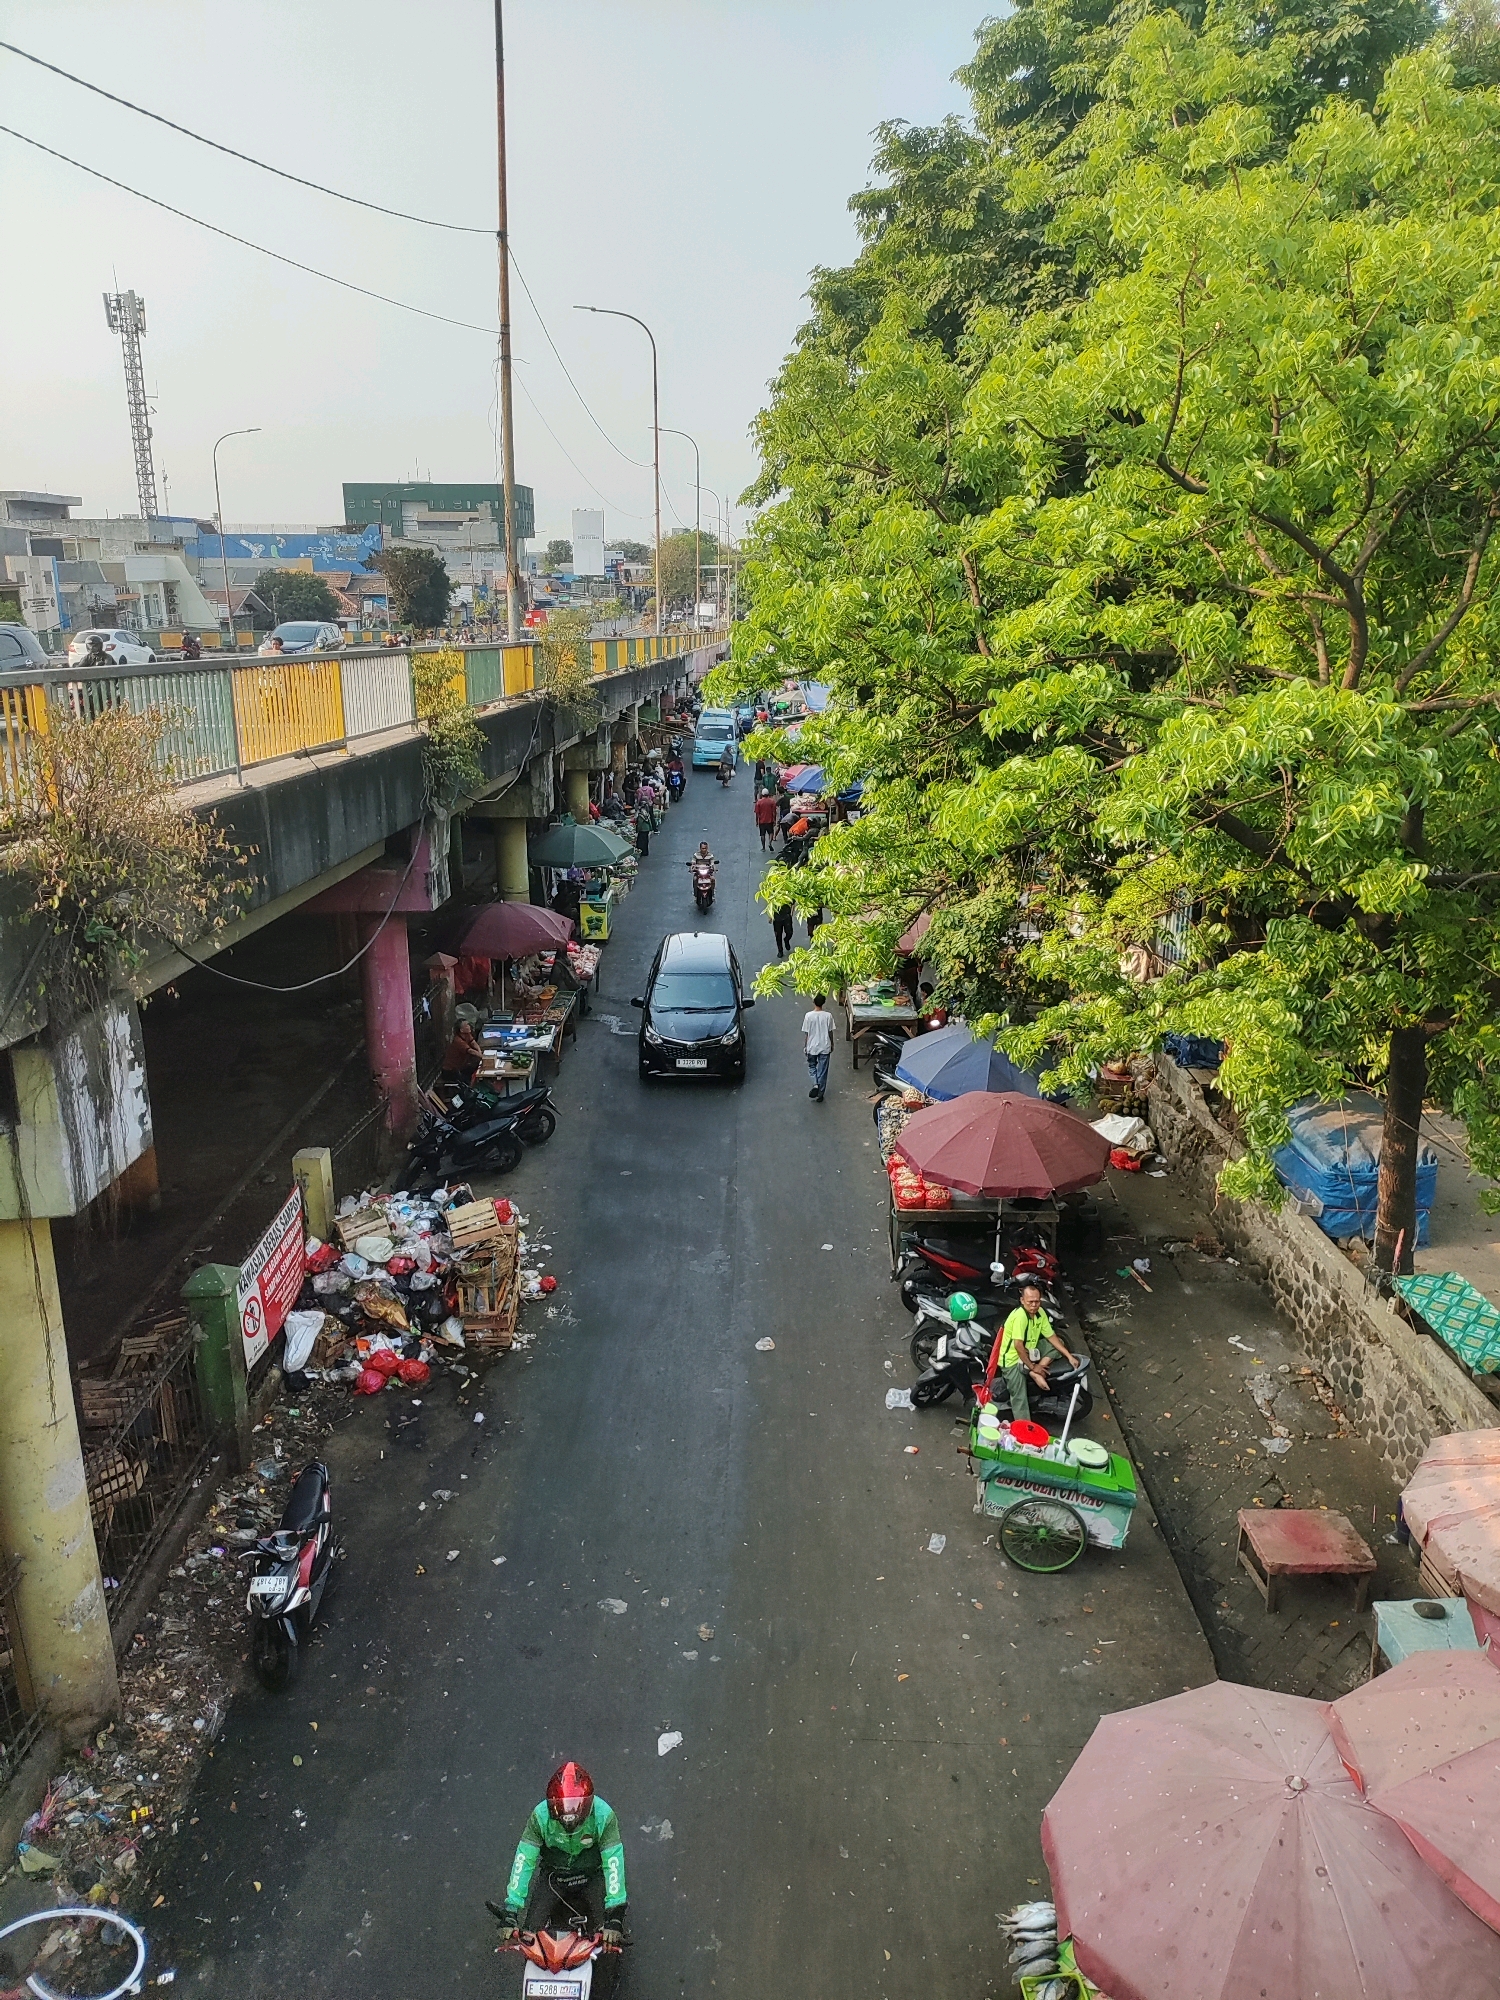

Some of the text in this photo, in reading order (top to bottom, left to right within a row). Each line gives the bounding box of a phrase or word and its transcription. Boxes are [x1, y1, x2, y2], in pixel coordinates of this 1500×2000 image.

[239, 1246, 266, 1297] KAWASAN
[262, 1222, 282, 1258] BEBAS
[512, 1852, 526, 1890] Grab
[607, 1856, 620, 1895] Grab
[528, 1984, 534, 1995] E
